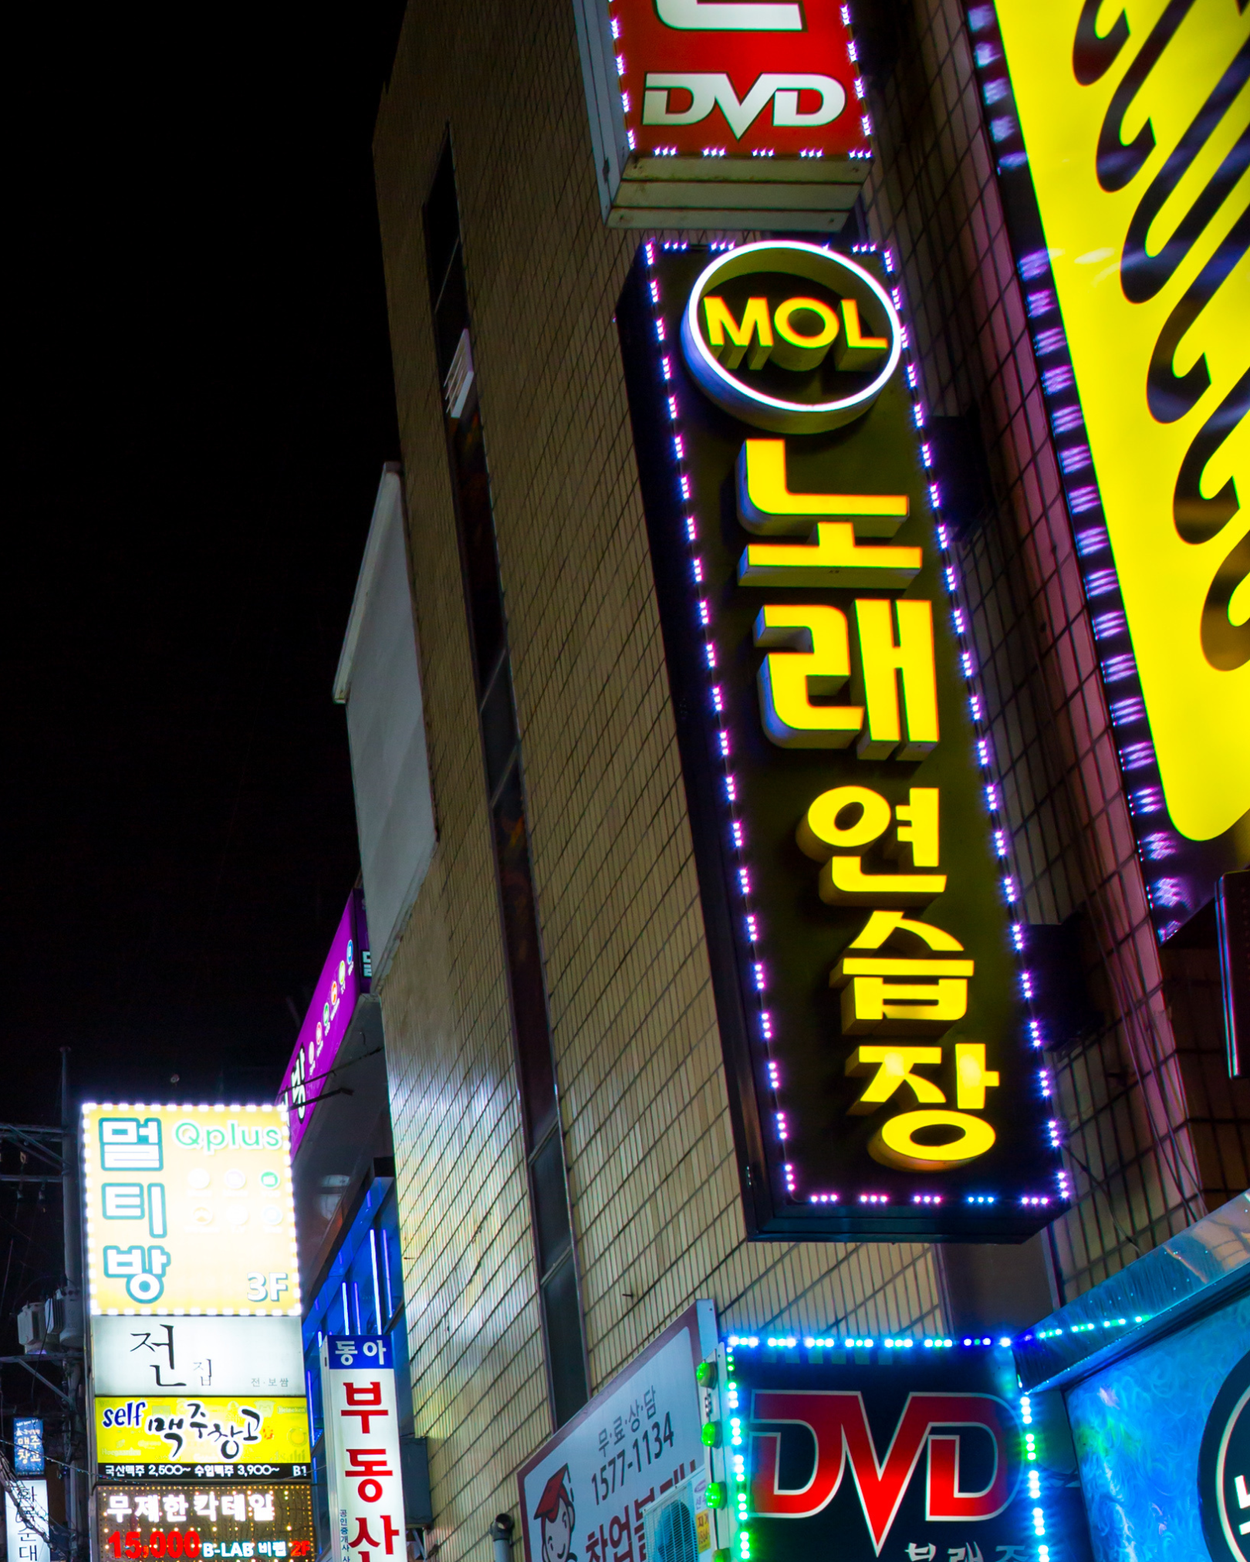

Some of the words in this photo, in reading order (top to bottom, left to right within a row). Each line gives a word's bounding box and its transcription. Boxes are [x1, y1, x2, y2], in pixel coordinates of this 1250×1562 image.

[642, 72, 847, 140] DVD
[703, 296, 889, 350] MOL
[738, 438, 1001, 1164] 노래연습장
[172, 1119, 285, 1155] Qplus
[98, 1117, 171, 1304] 멀티방
[247, 1271, 288, 1303] 3F
[335, 1340, 387, 1366] 동아
[102, 1401, 146, 1428] self
[147, 1402, 261, 1460] 맥주창고
[292, 1465, 307, 1477] B1
[590, 1410, 675, 1506] 1577-1134
[750, 1389, 1026, 1558] DVD
[106, 1494, 188, 1523] 무제한
[339, 1509, 350, 1553] 공인중개사
[108, 1530, 200, 1559] 15,000
[203, 1542, 254, 1558] B-LAB
